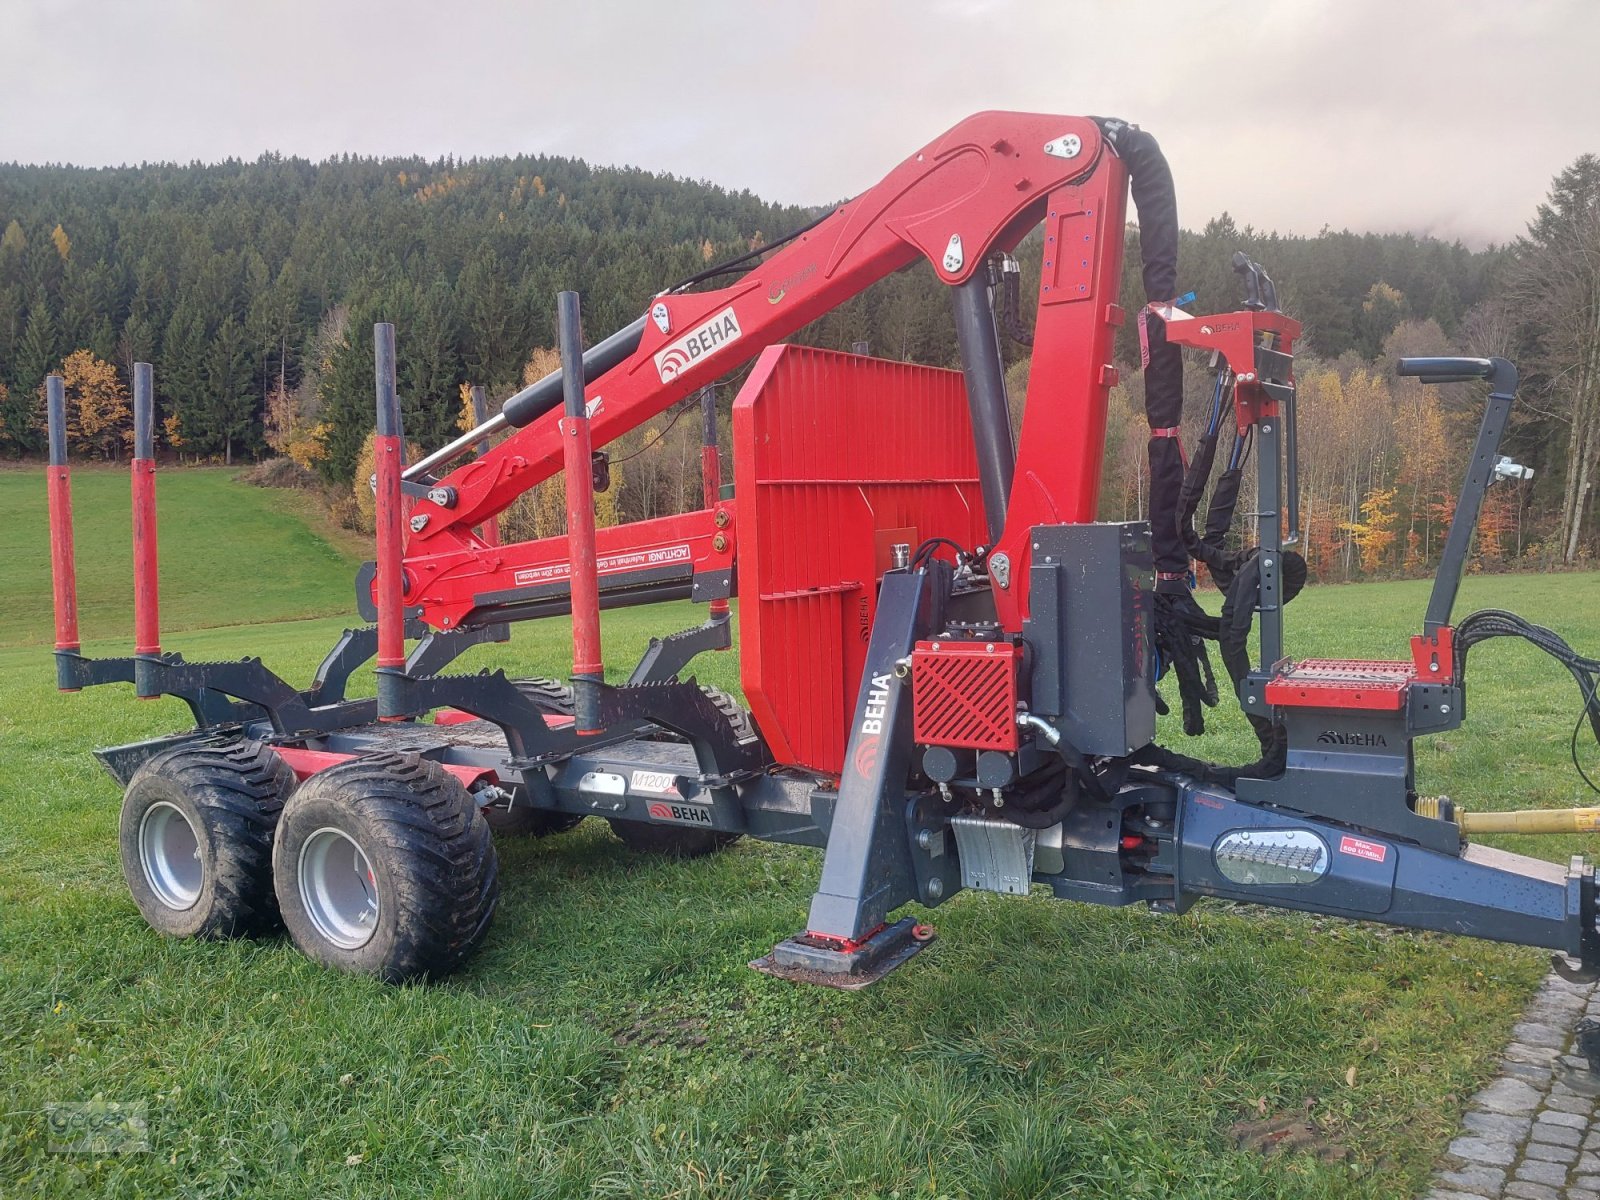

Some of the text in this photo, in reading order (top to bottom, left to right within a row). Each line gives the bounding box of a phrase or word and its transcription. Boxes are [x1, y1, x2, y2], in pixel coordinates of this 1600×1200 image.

[1215, 322, 1239, 332] BEHA
[686, 315, 738, 359] BEHA
[648, 547, 687, 562] ACHTUNG!
[860, 596, 868, 625] BEHA
[862, 673, 892, 734] BEHA
[1345, 732, 1387, 747] BEHA
[633, 773, 671, 788] M1200
[671, 806, 711, 822] BEHA
[1355, 841, 1372, 850] Max.
